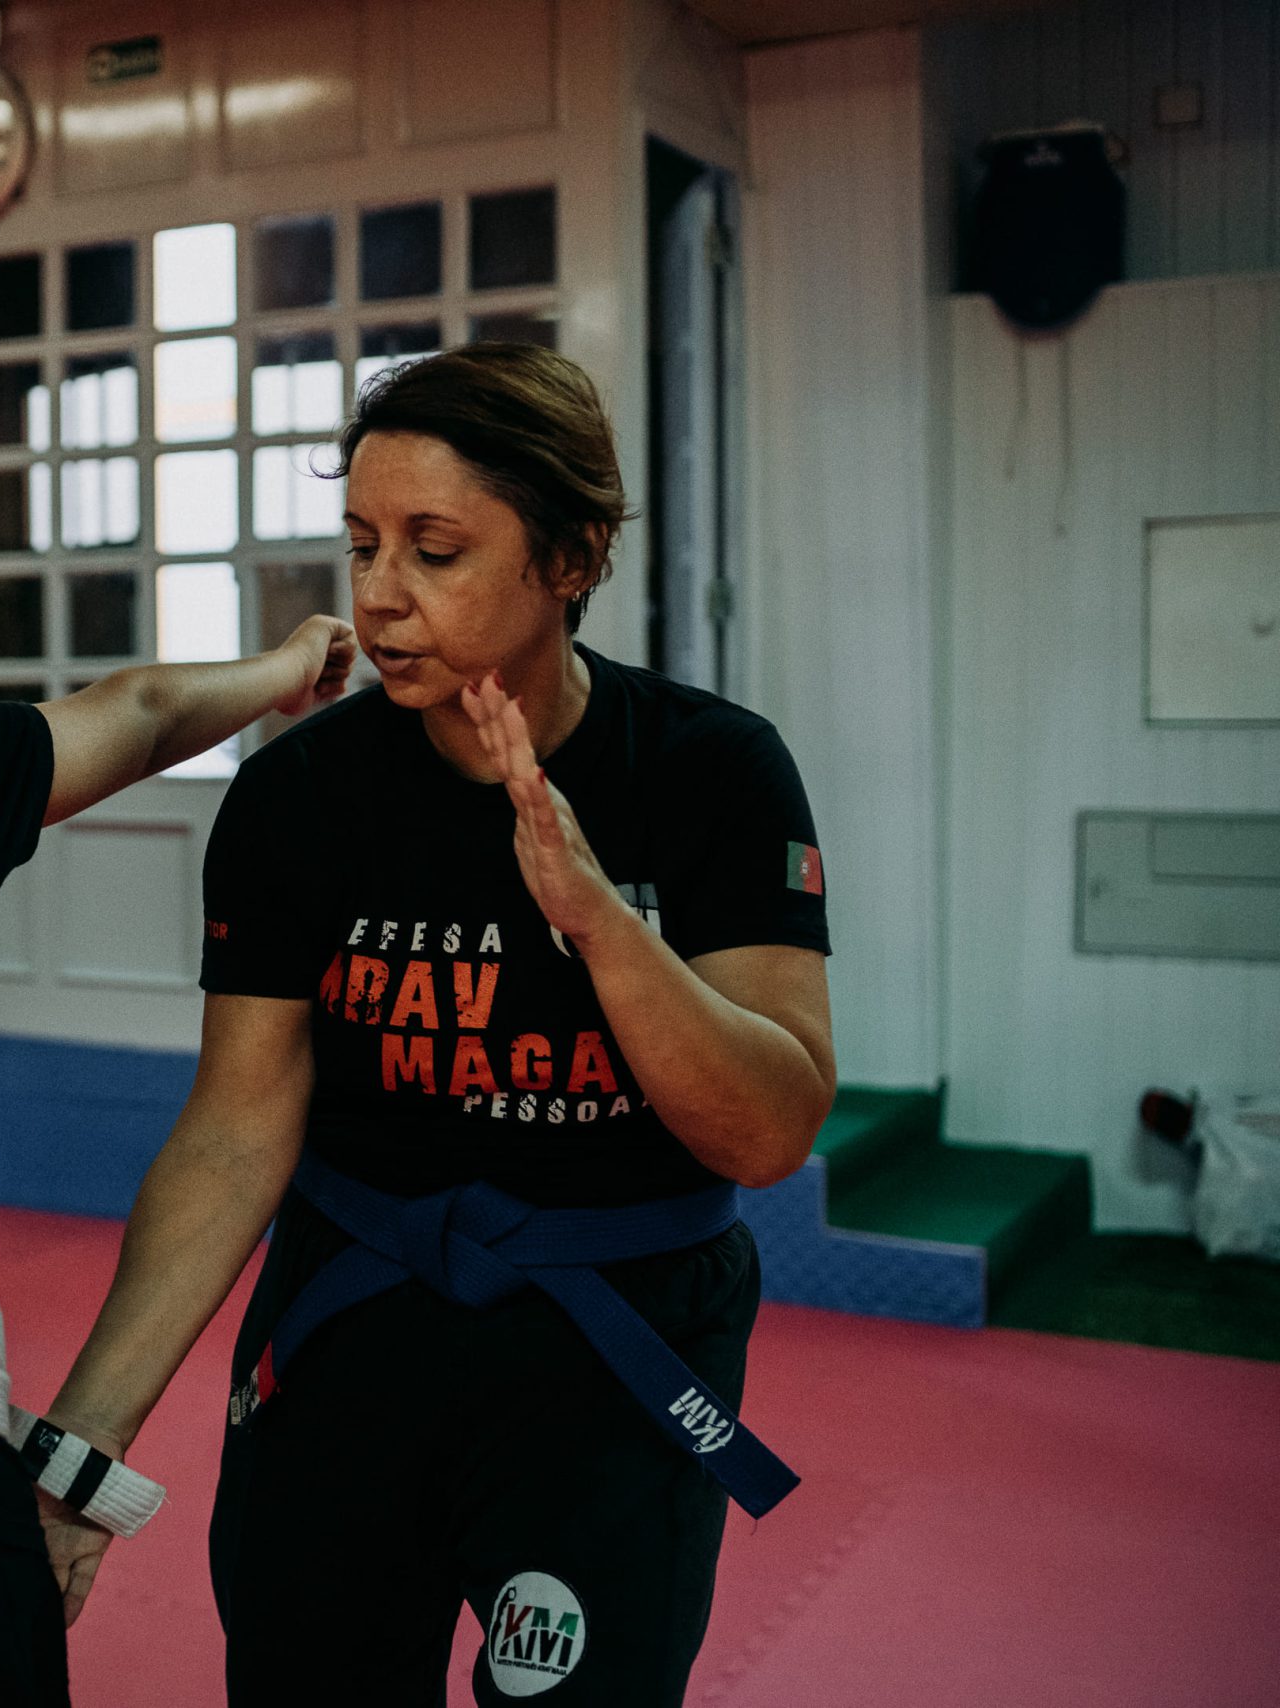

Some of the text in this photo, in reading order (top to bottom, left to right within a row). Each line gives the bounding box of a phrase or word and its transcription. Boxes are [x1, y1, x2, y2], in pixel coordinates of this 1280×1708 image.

[347, 917, 503, 954] EFESA
[381, 1030, 619, 1096] MAGA
[463, 1091, 649, 1124] PESSOA
